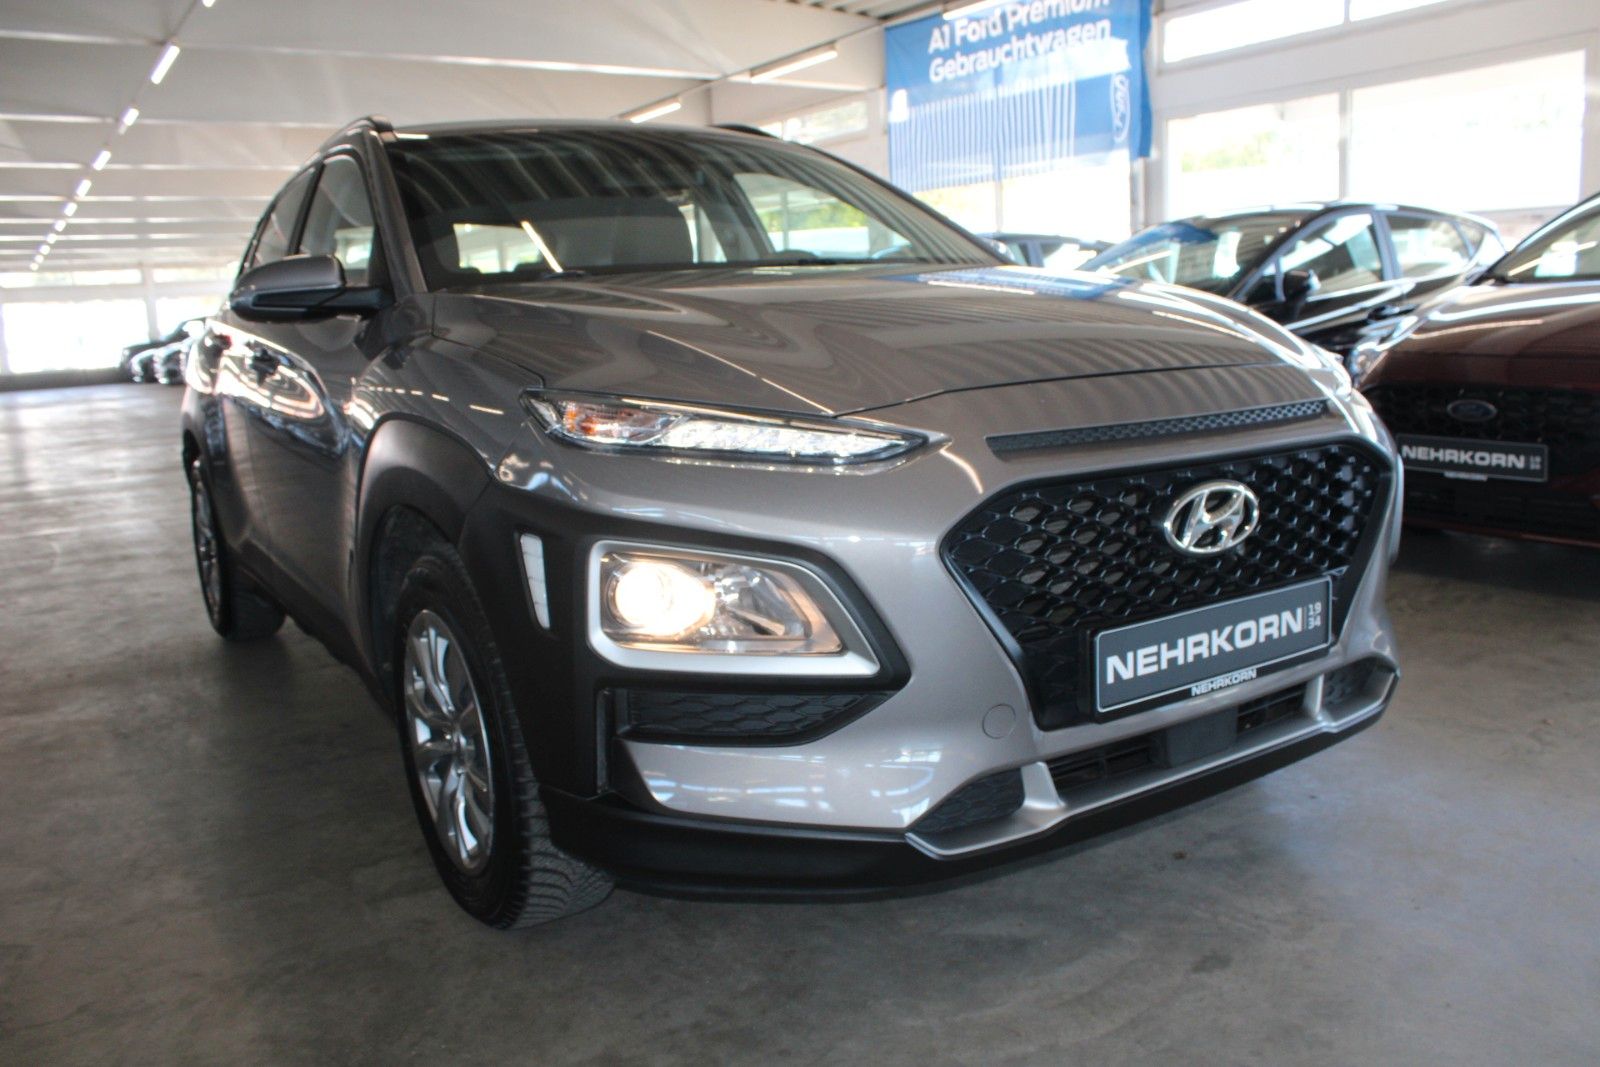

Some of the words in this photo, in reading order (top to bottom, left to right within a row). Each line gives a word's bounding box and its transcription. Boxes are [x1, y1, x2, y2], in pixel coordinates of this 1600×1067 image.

[927, 27, 951, 54] A1
[955, 8, 1002, 46] Ford
[928, 18, 1112, 83] Gebrauchtwagen
[1400, 445, 1526, 470] NEHRKORN
[1105, 607, 1303, 684] NEHRKORN
[1191, 668, 1257, 697] NEHRKORN
